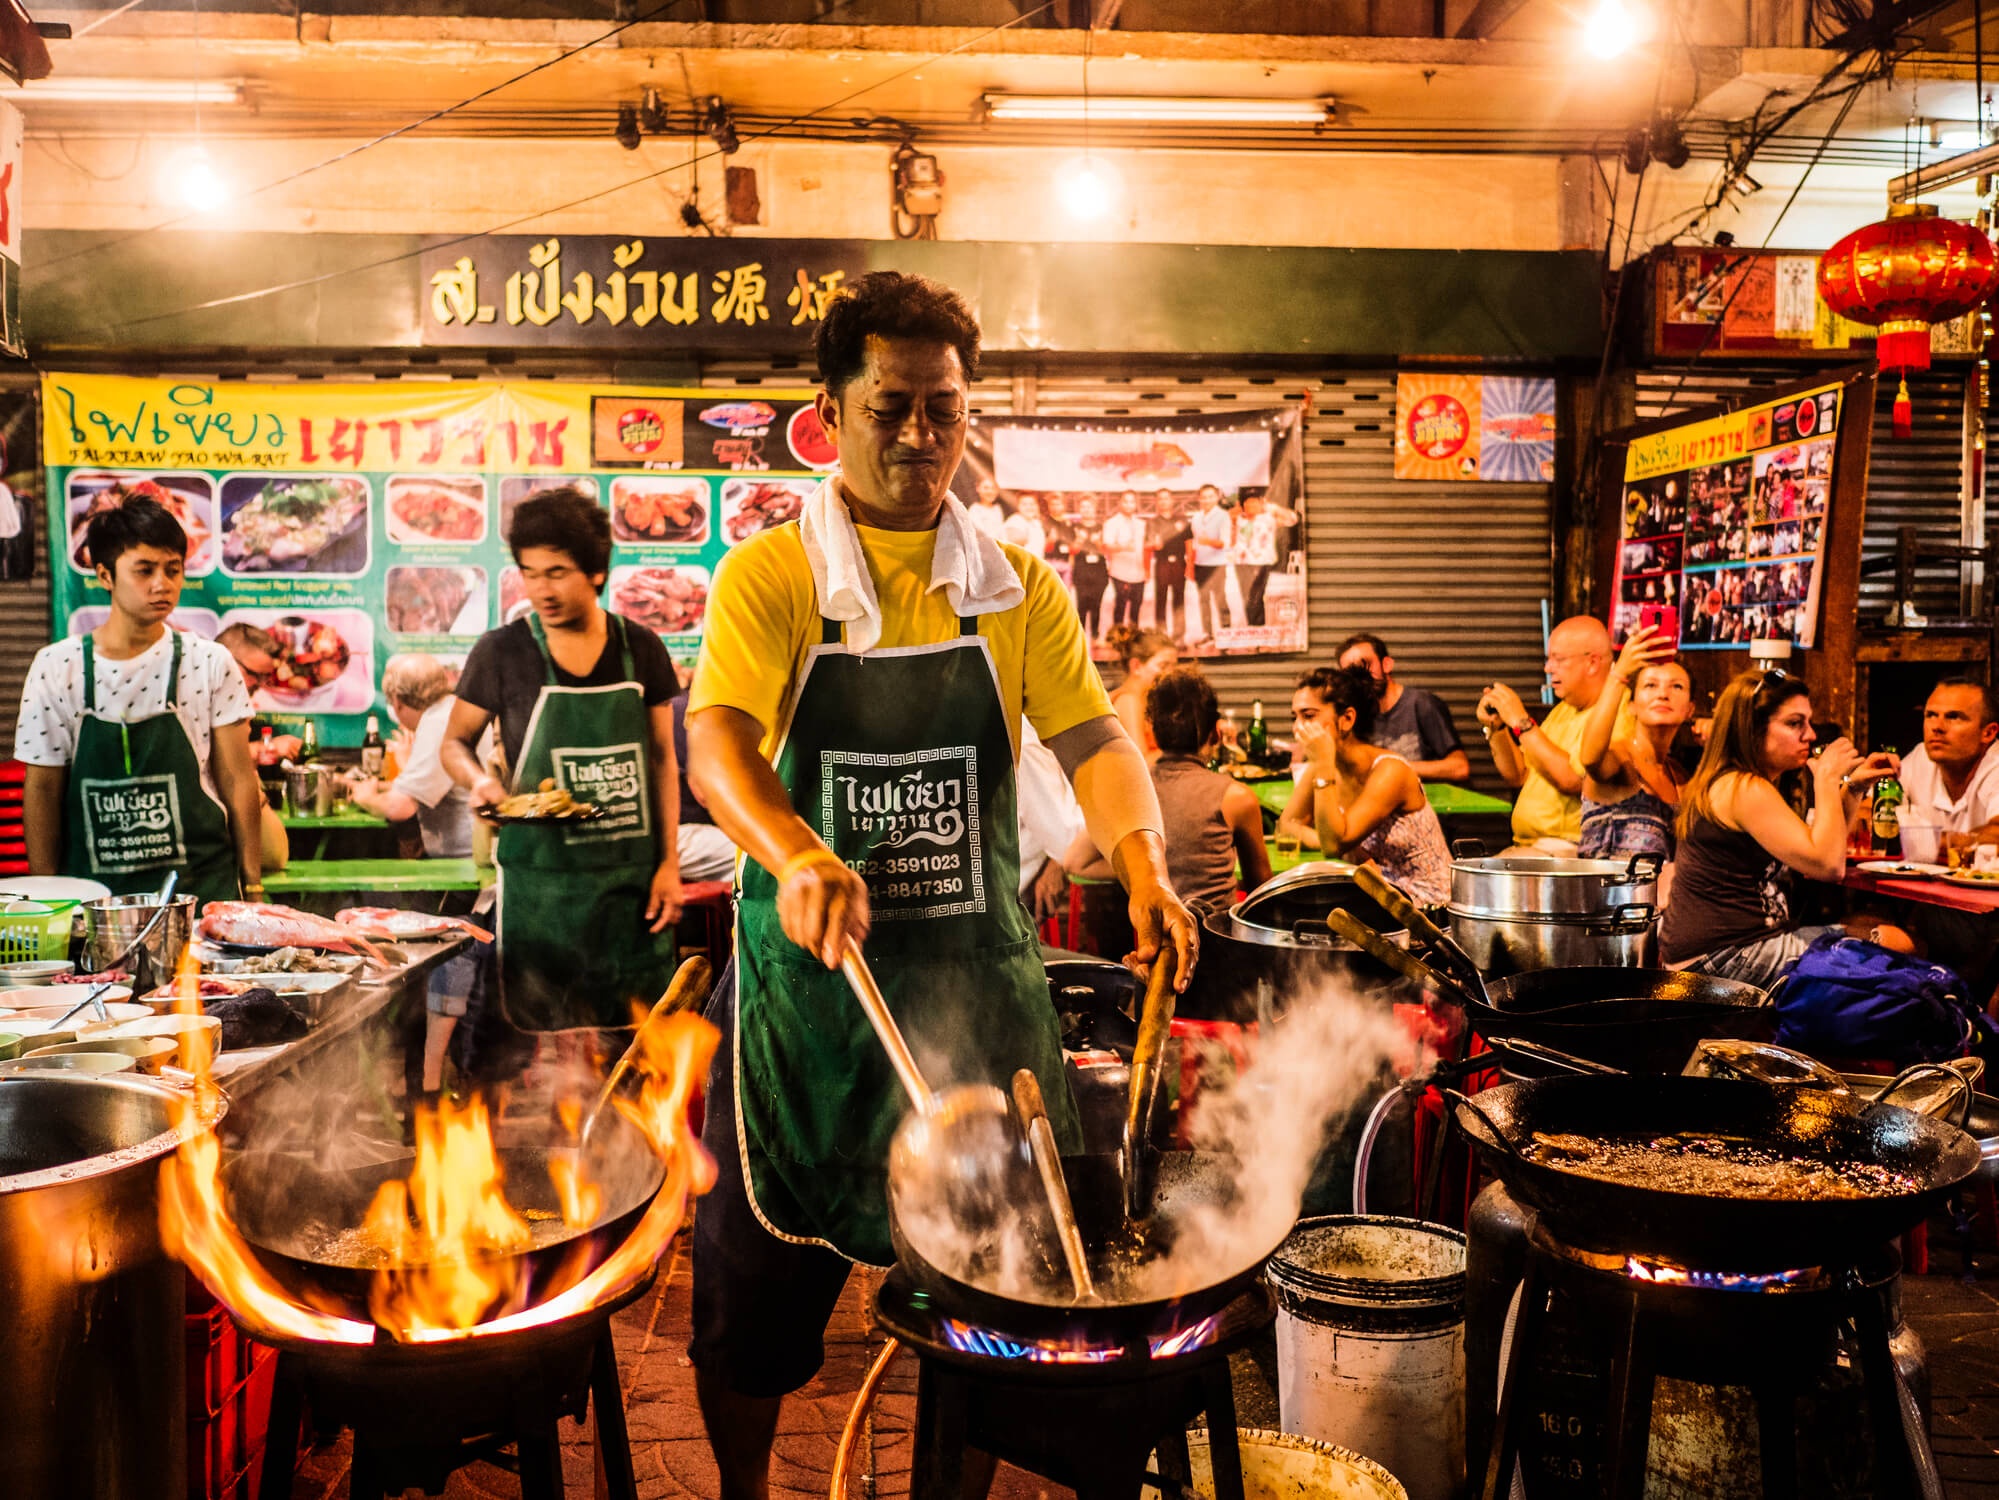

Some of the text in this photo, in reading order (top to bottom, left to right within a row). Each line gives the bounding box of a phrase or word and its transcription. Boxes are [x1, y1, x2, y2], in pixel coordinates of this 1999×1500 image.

[299, 416, 569, 468] เยาวราช
[836, 769, 961, 814] ไฟเขียว
[851, 811, 931, 833] เยาวราช
